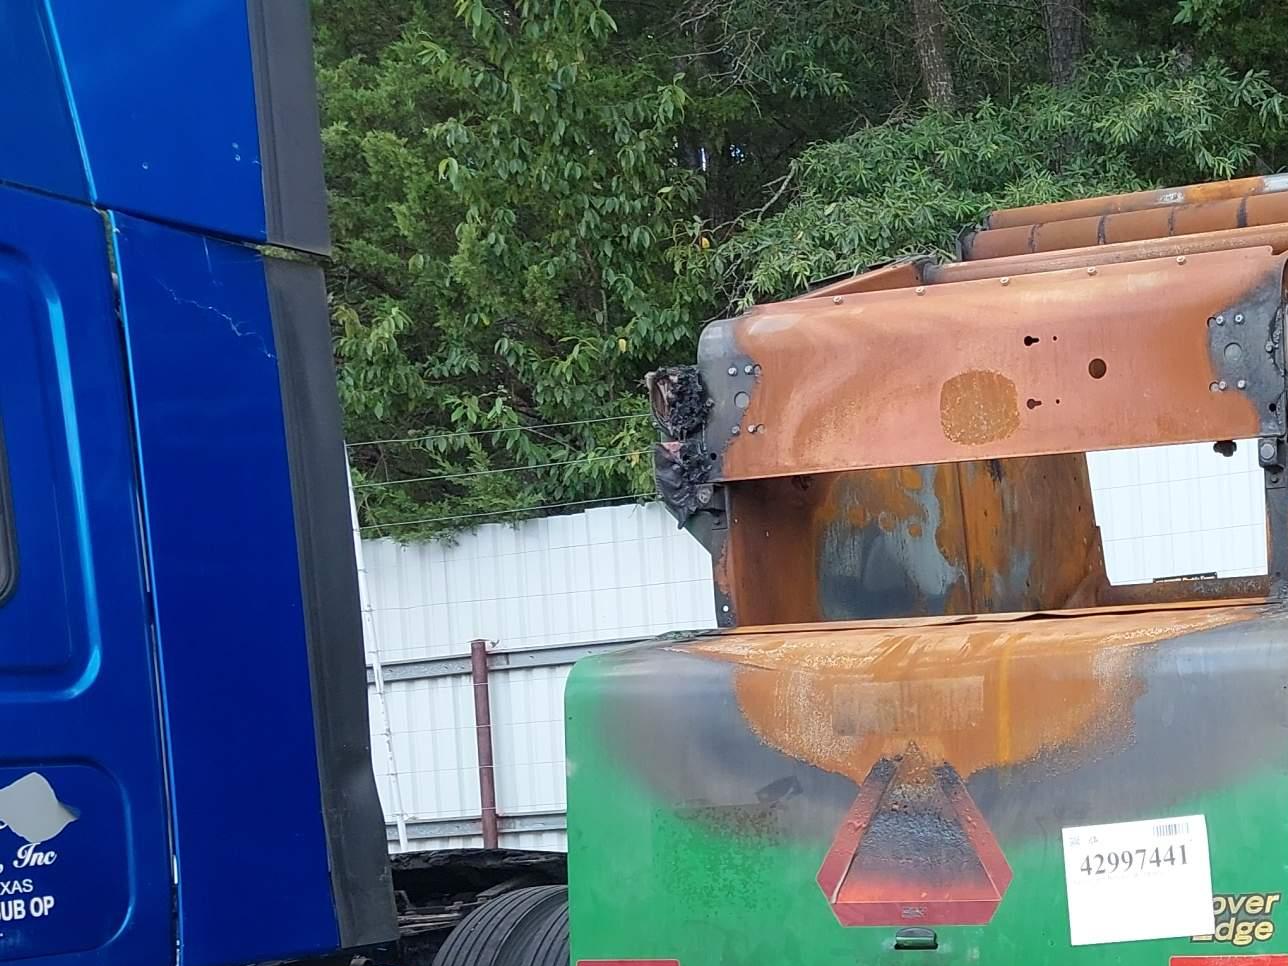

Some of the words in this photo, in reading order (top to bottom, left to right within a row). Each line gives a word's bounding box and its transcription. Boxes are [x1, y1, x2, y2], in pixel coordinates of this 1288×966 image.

[13, 842, 57, 868] Inc
[1080, 844, 1188, 875] 42997441
[0, 899, 26, 921] UB
[29, 895, 55, 917] OP
[1191, 916, 1274, 946] dge
